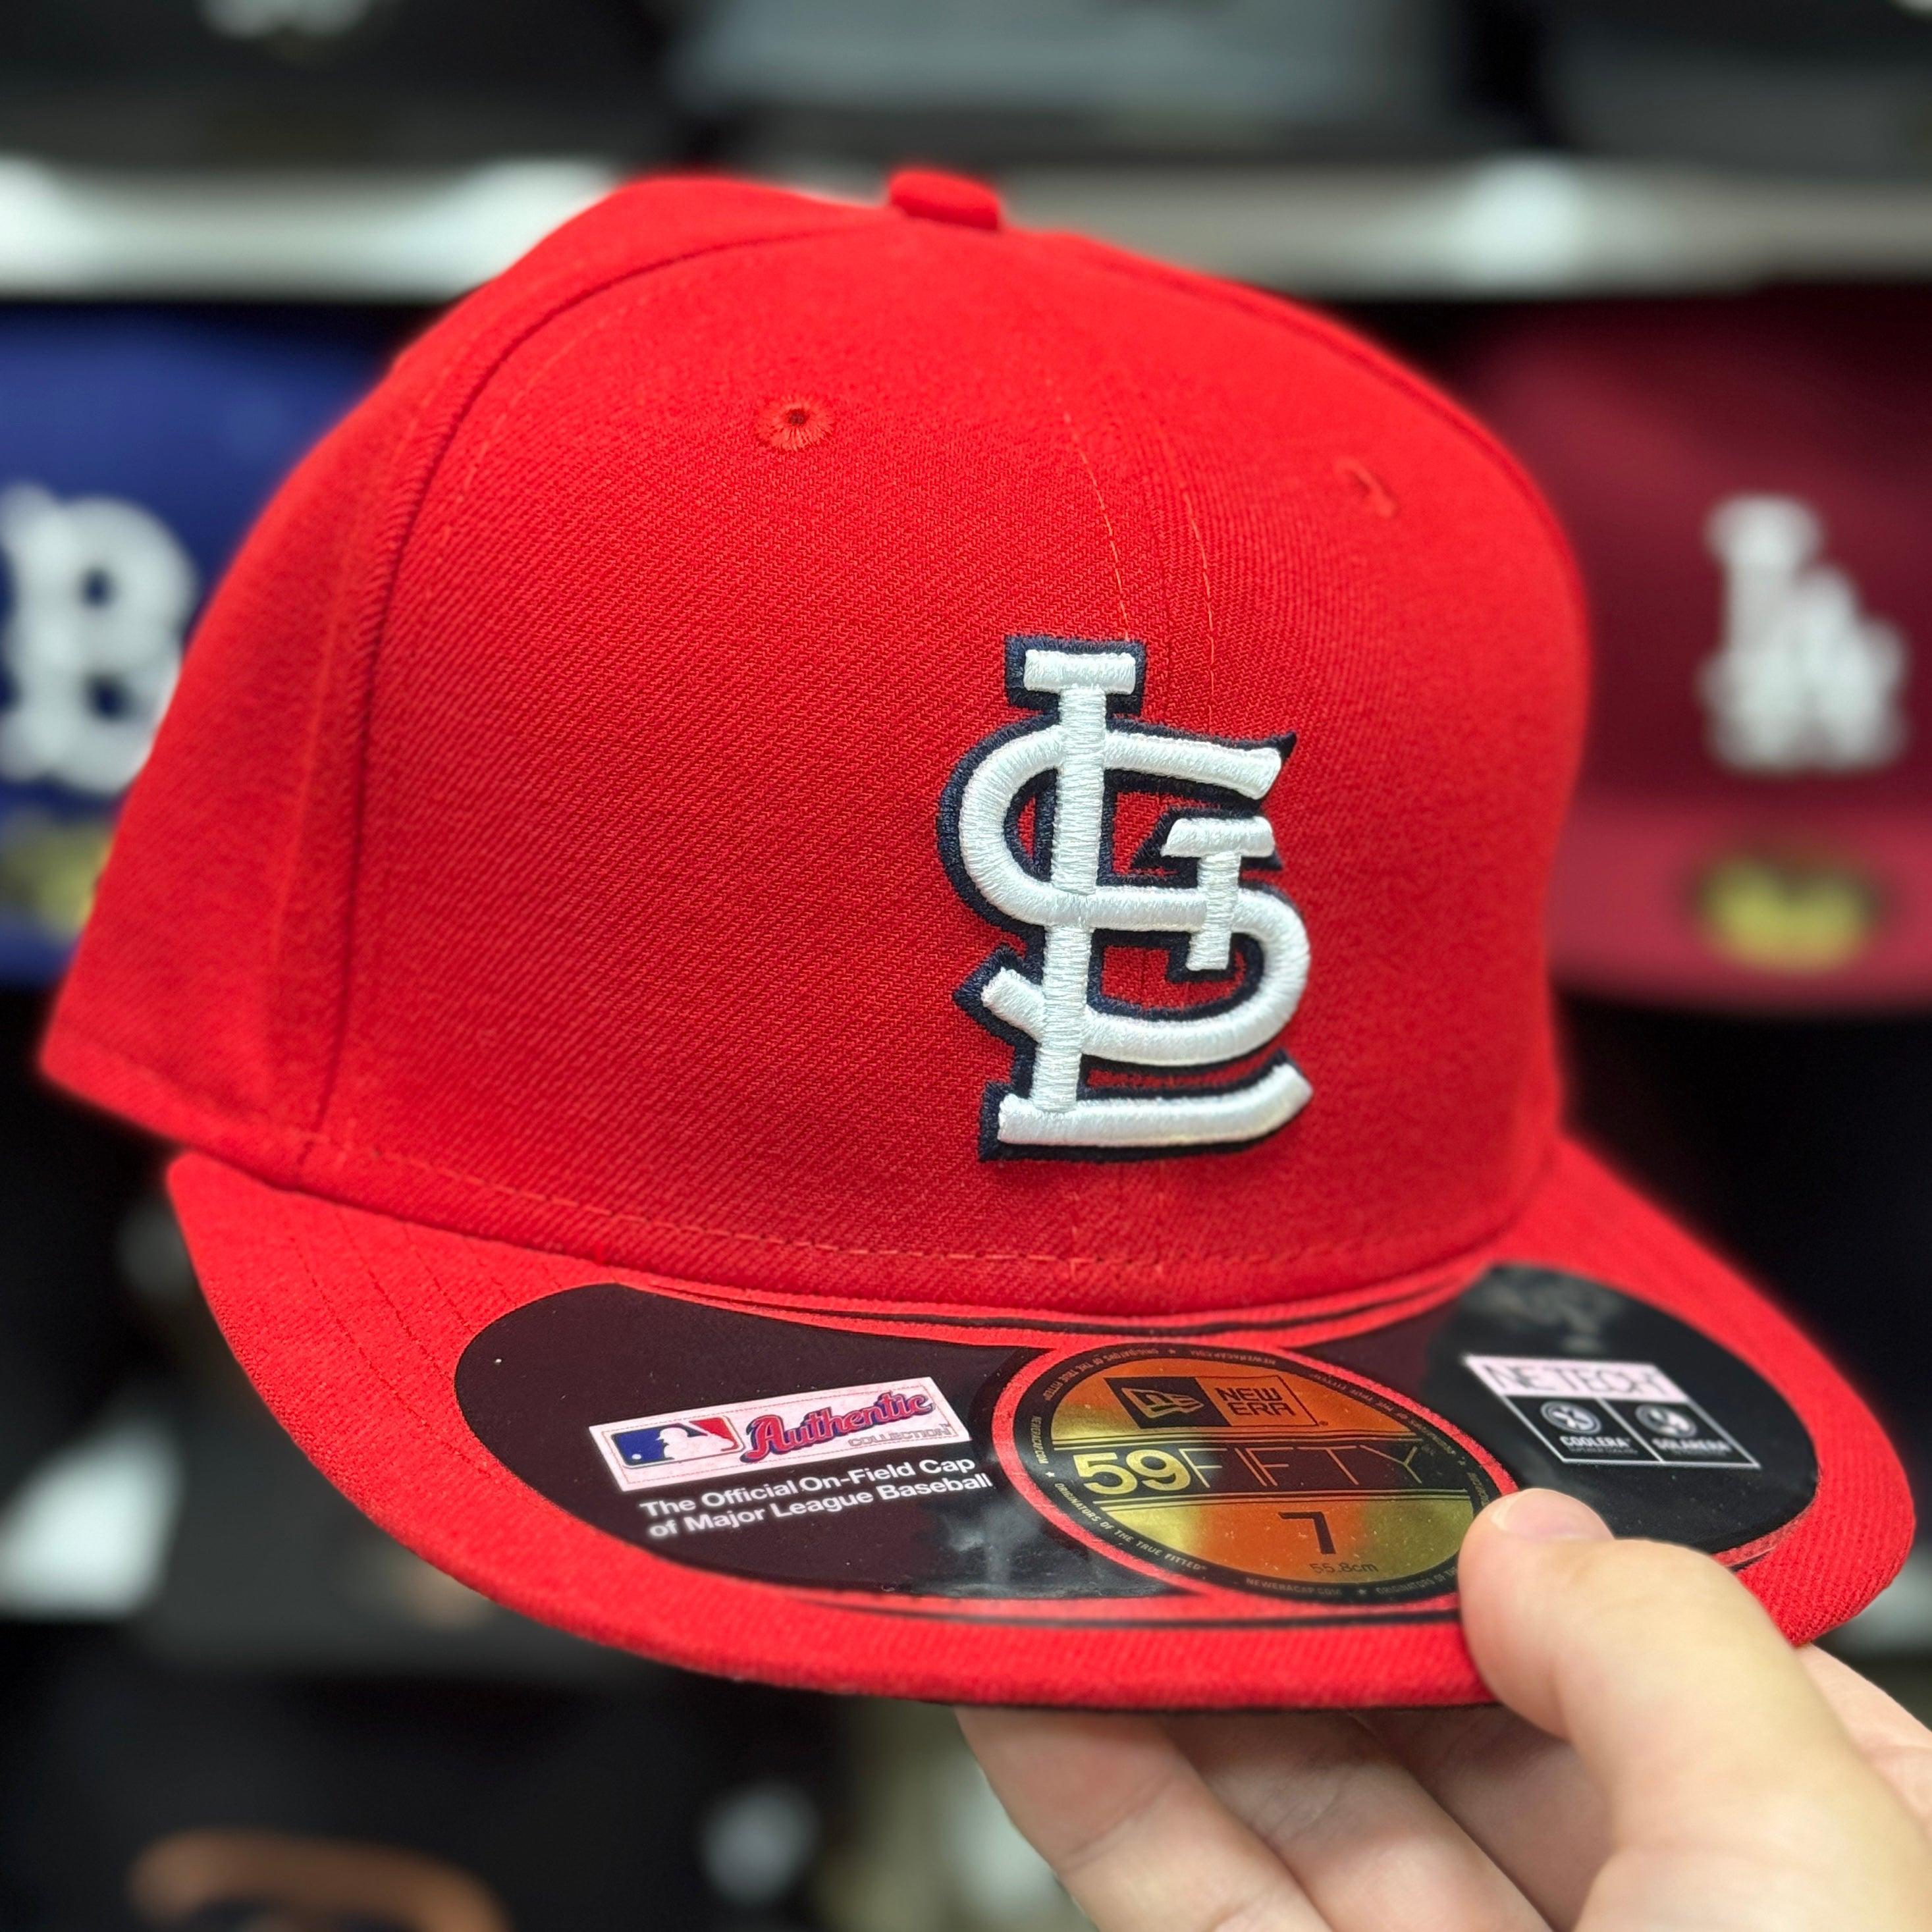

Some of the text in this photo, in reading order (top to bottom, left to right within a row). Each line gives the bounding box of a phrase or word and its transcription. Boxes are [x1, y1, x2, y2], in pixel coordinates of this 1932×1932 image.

[1215, 1387, 1283, 1401] NEW
[1227, 1402, 1297, 1416] ERA
[739, 1391, 936, 1463] Authentic
[848, 1428, 950, 1447] COLLECTION
[639, 1459, 976, 1516] The Official On-Field Cap
[1073, 1445, 1422, 1495] 59FIFTY
[649, 1473, 993, 1537] of Major League Baseball
[1054, 1483, 1102, 1522] ORIGINATORS
[1100, 1521, 1114, 1532] OF
[1114, 1530, 1135, 1542] THE
[1135, 1540, 1162, 1556] TRUE
[1277, 1511, 1337, 1555] 7
[1310, 1563, 1378, 1574] 55.8cm
